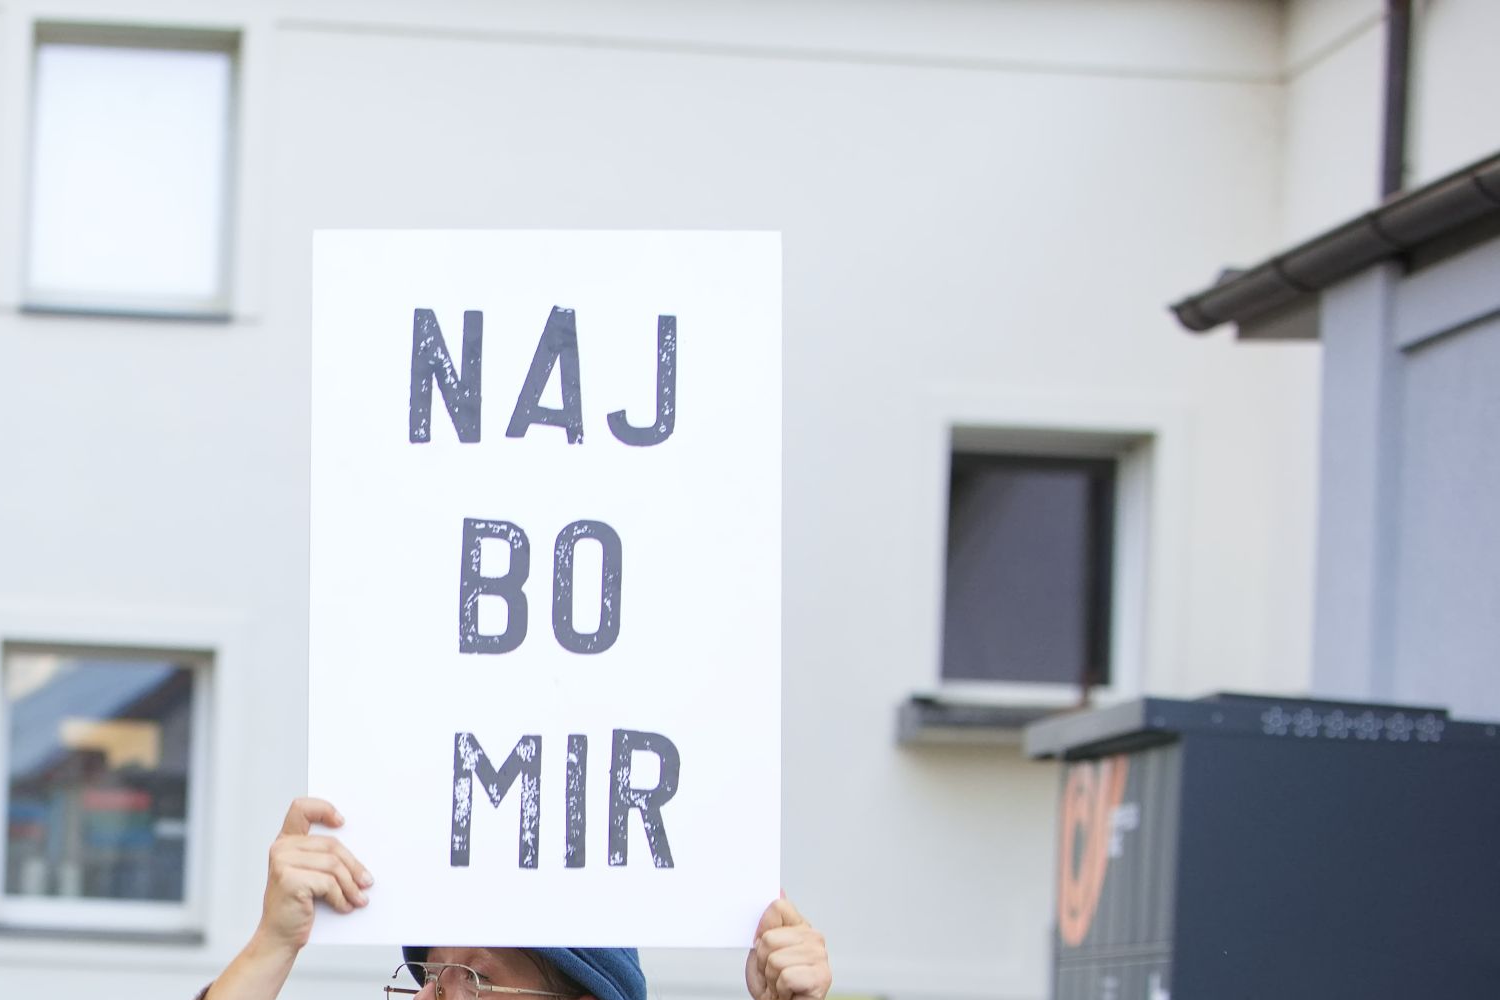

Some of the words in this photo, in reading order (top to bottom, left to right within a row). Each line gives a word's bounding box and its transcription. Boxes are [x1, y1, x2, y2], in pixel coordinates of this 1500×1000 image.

[409, 305, 677, 447] NAJ
[459, 517, 622, 654] BO
[450, 728, 681, 869] MIR
